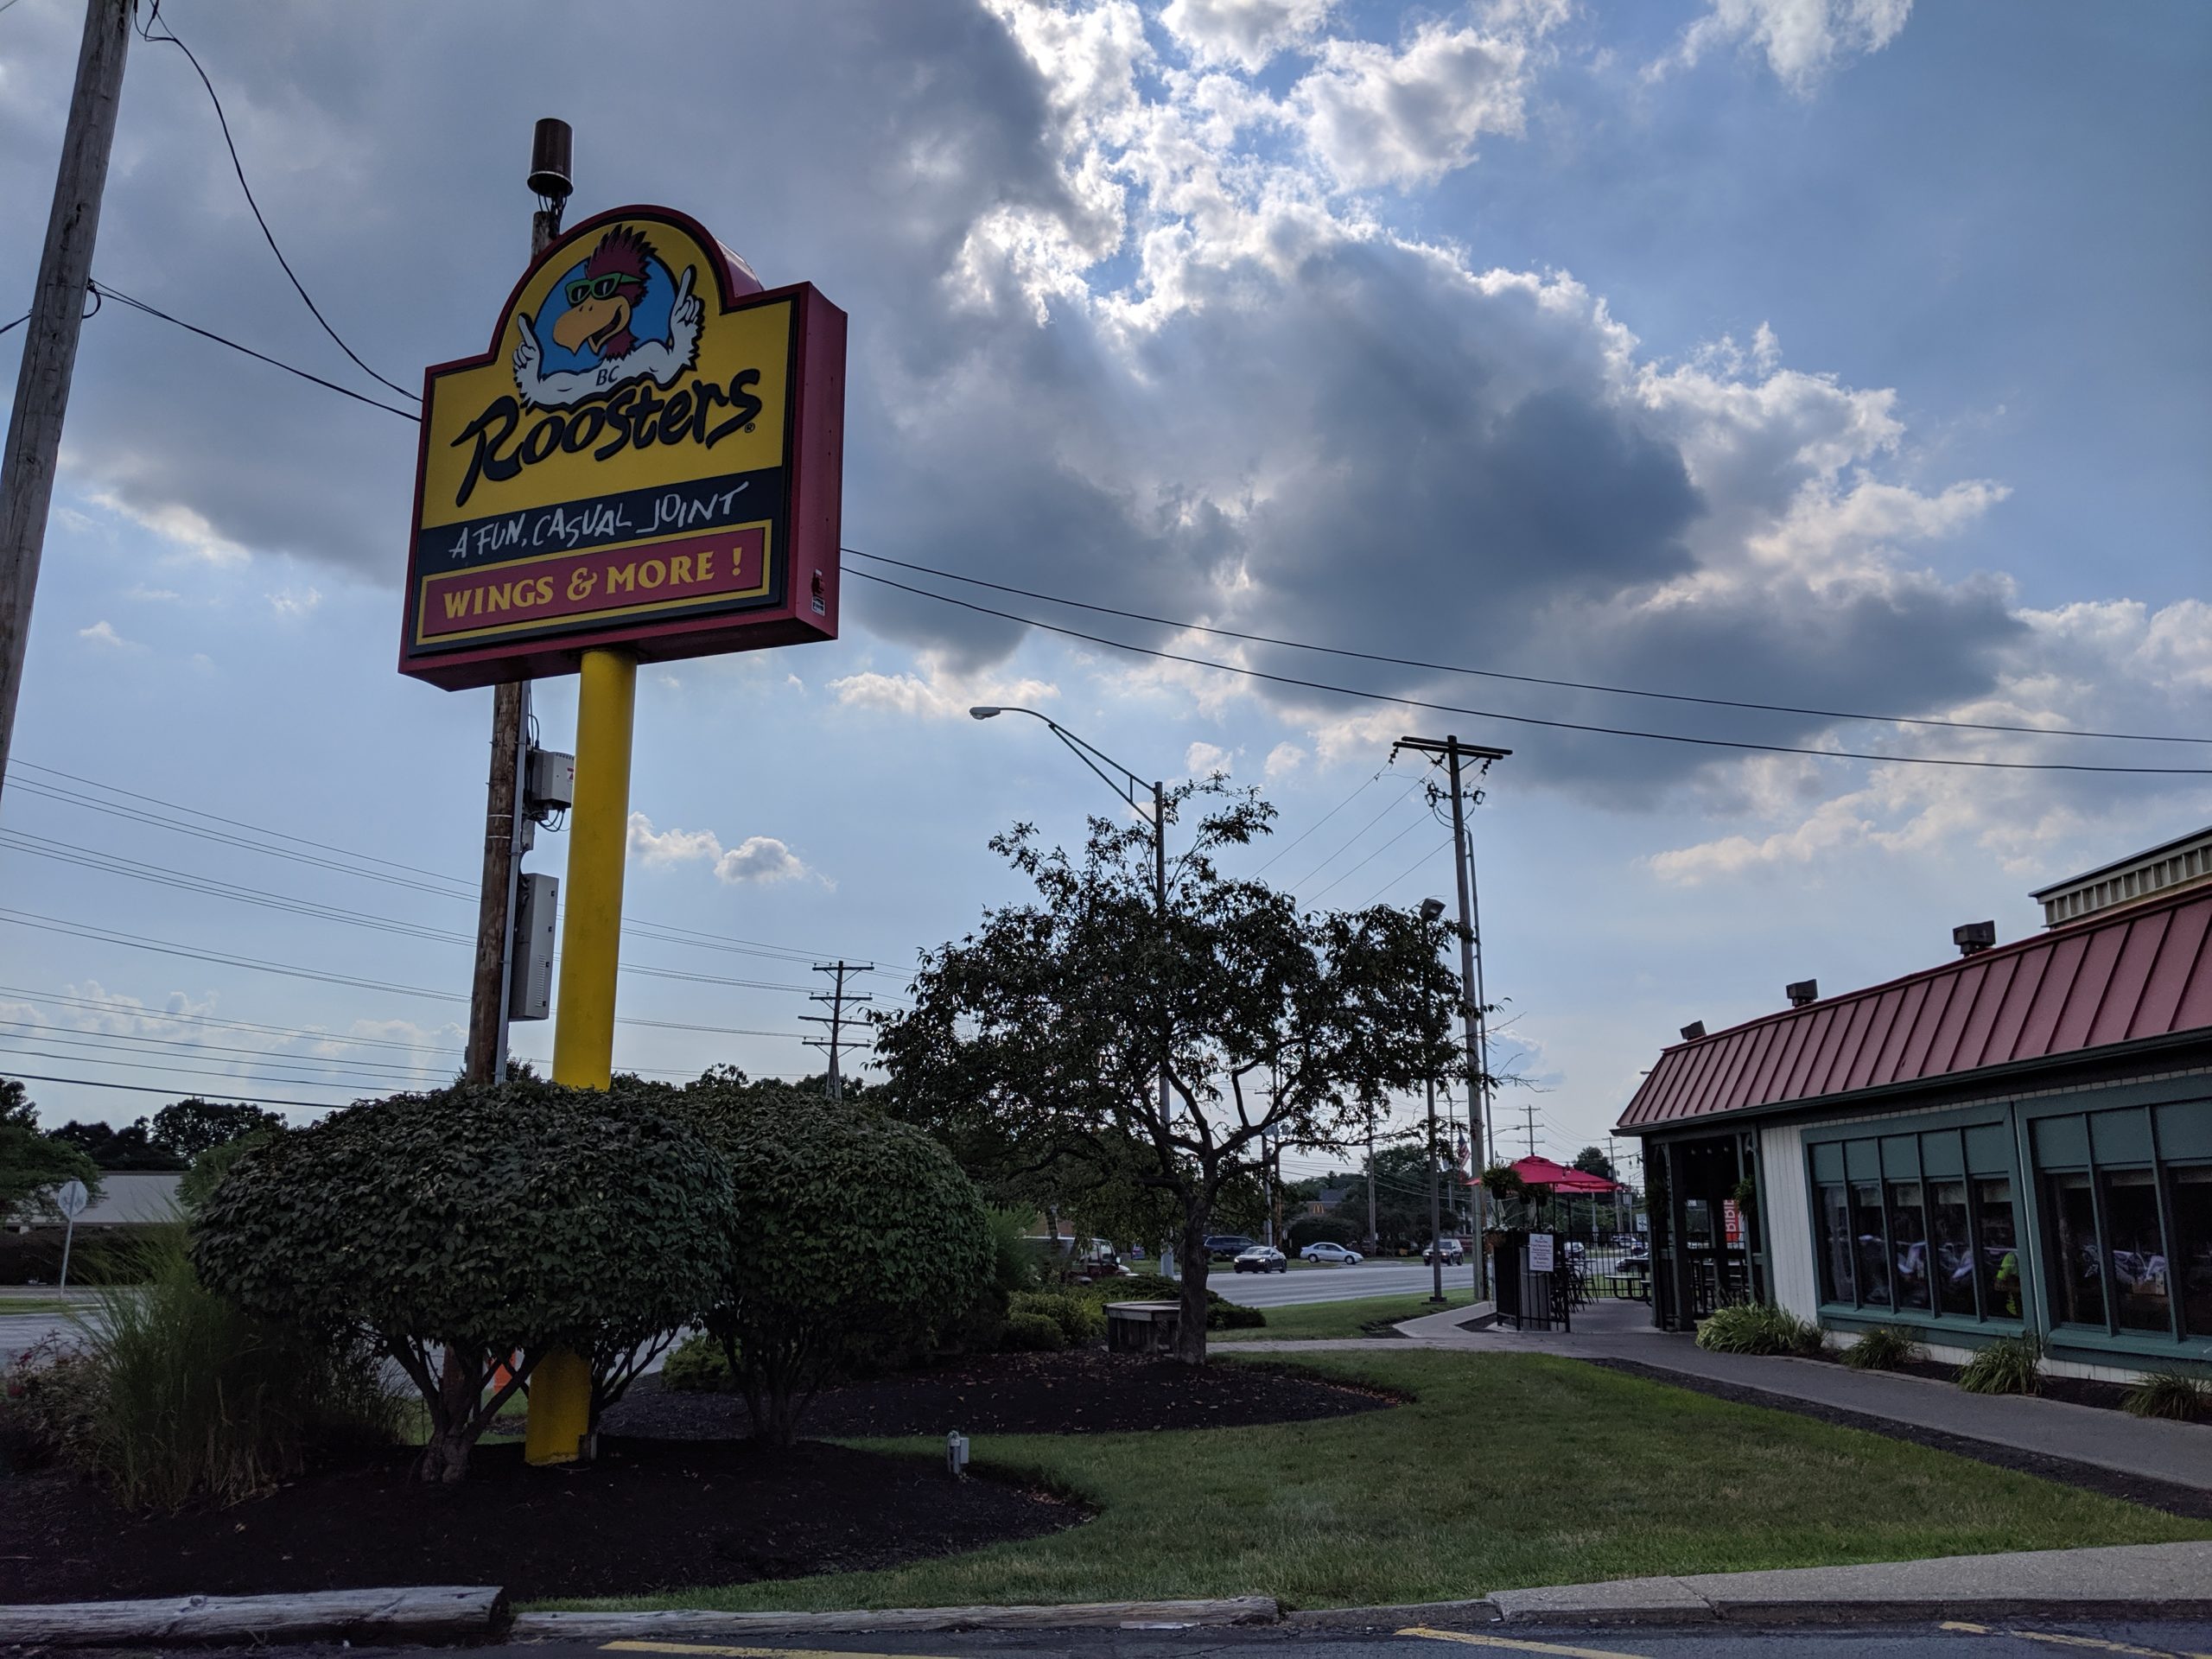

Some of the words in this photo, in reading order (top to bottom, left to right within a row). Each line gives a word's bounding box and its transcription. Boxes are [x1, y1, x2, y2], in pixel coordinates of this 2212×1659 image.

[596, 365, 620, 386] BC
[450, 368, 762, 507] Roosters
[448, 526, 468, 558] A
[532, 503, 632, 548] CASUAL
[635, 480, 749, 534] JOINT
[443, 575, 554, 620] WINGS
[567, 567, 598, 601] &
[606, 550, 715, 594] MORE
